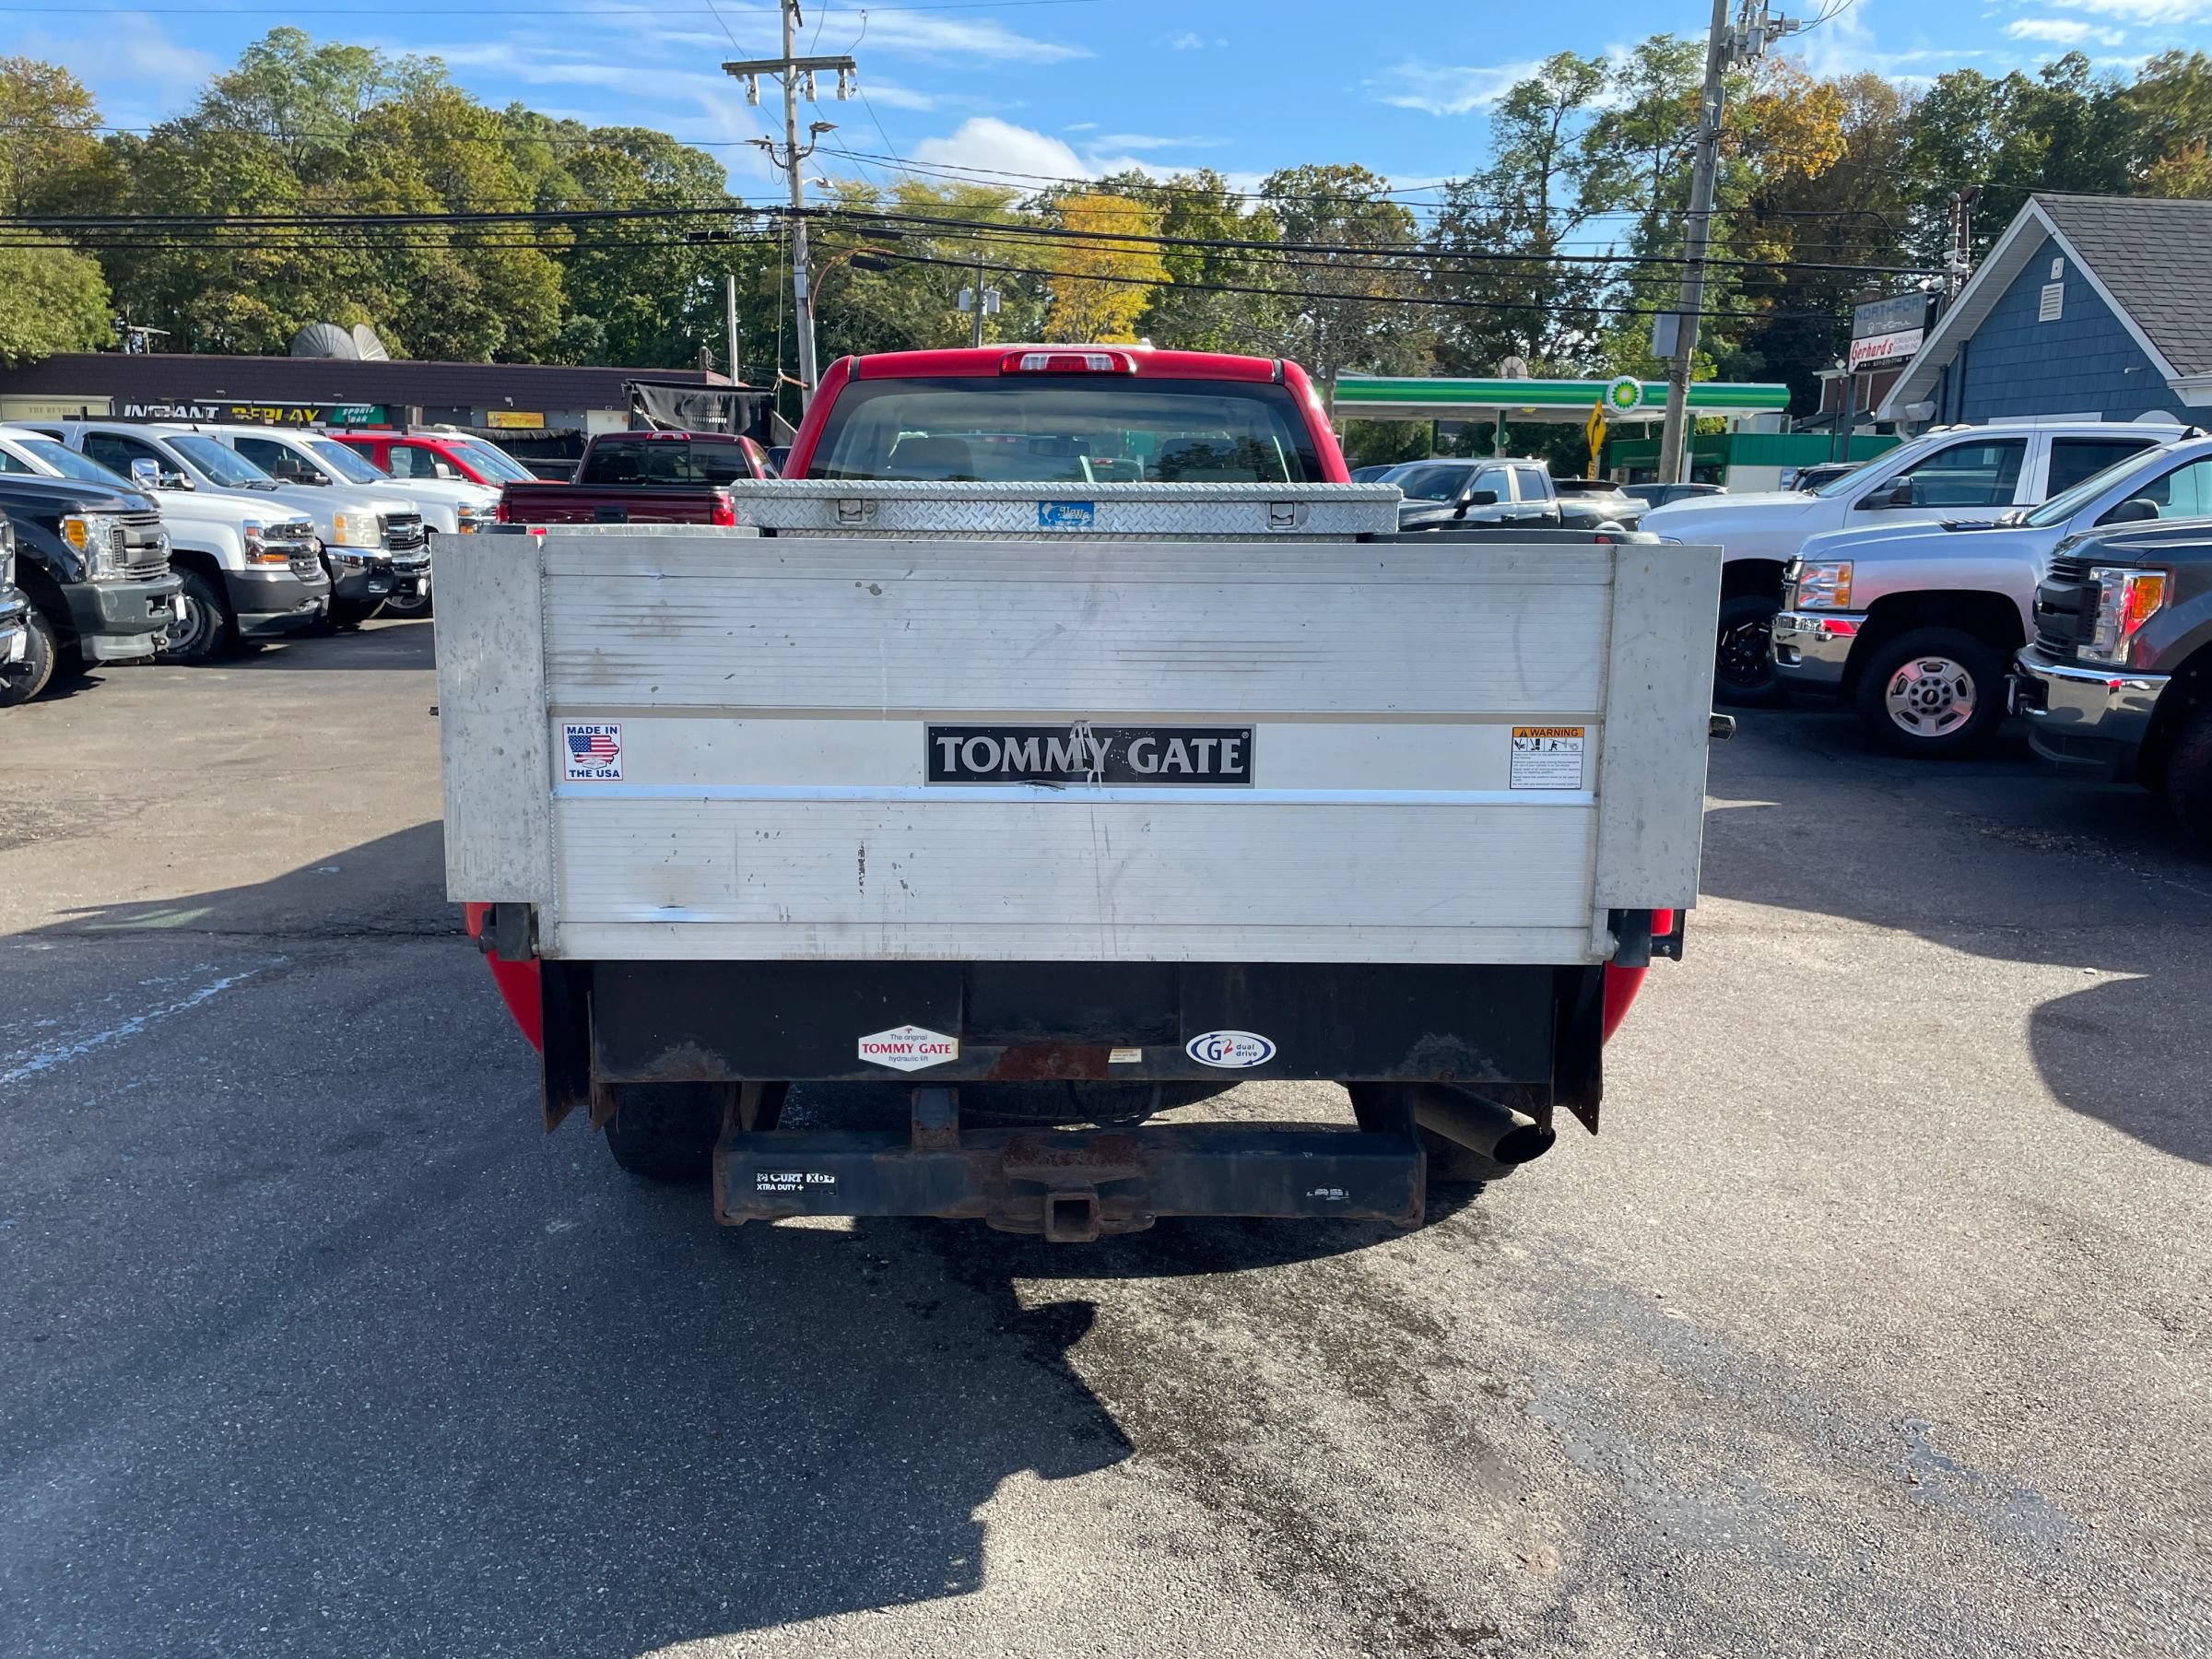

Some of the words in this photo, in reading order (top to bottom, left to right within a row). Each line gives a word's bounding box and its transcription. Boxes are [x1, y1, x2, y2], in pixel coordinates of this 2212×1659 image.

[1852, 337, 1894, 366] Gerhard's
[47, 406, 78, 414] RETREA
[567, 726, 601, 735] MADE
[606, 726, 618, 735] IN
[936, 736, 1113, 772] TOMMY
[569, 770, 593, 778] THE
[596, 770, 620, 778] USA
[863, 1043, 913, 1053] TOMMY
[919, 1043, 952, 1053] GATE
[770, 1173, 803, 1182] CURT
